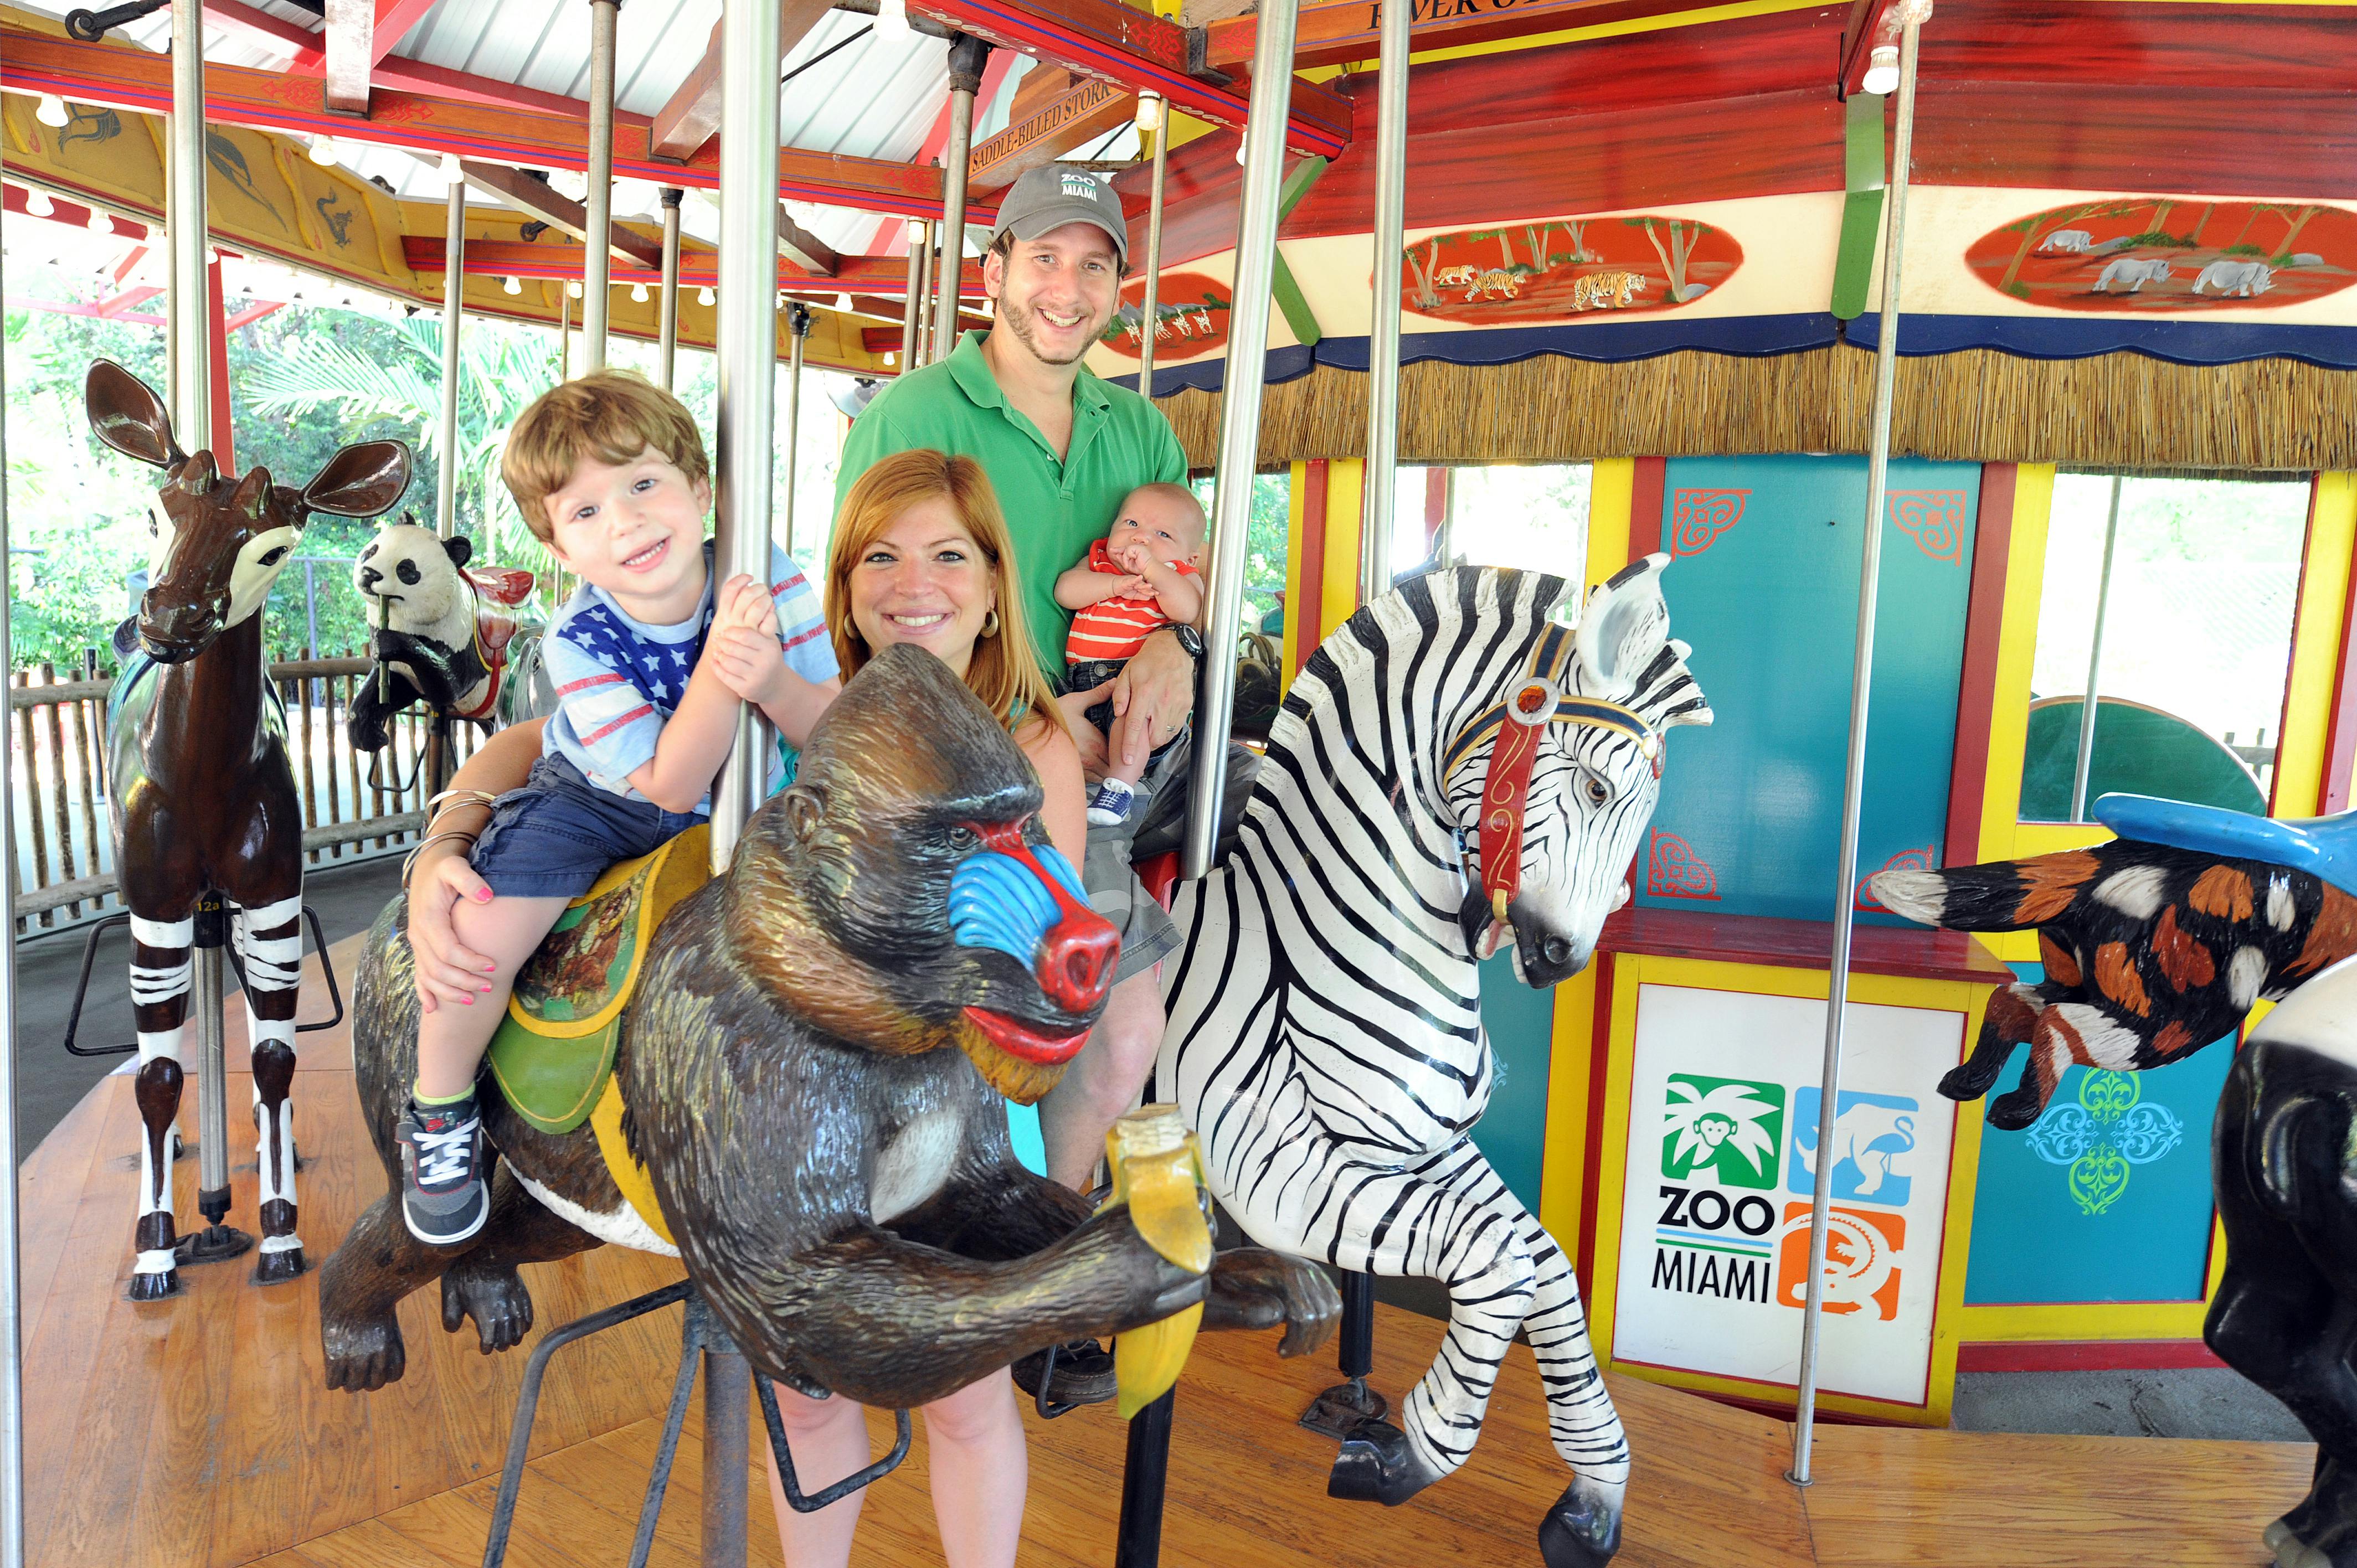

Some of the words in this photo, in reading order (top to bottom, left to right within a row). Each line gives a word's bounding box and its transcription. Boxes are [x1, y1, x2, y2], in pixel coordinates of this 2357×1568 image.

[972, 105, 1061, 172] SADDLE-BILLED
[1061, 174, 1096, 187] ZOO
[1062, 185, 1097, 202] MIAMI
[1657, 1185, 1775, 1236] ZOO
[1651, 1248, 1771, 1303] MIAMI
